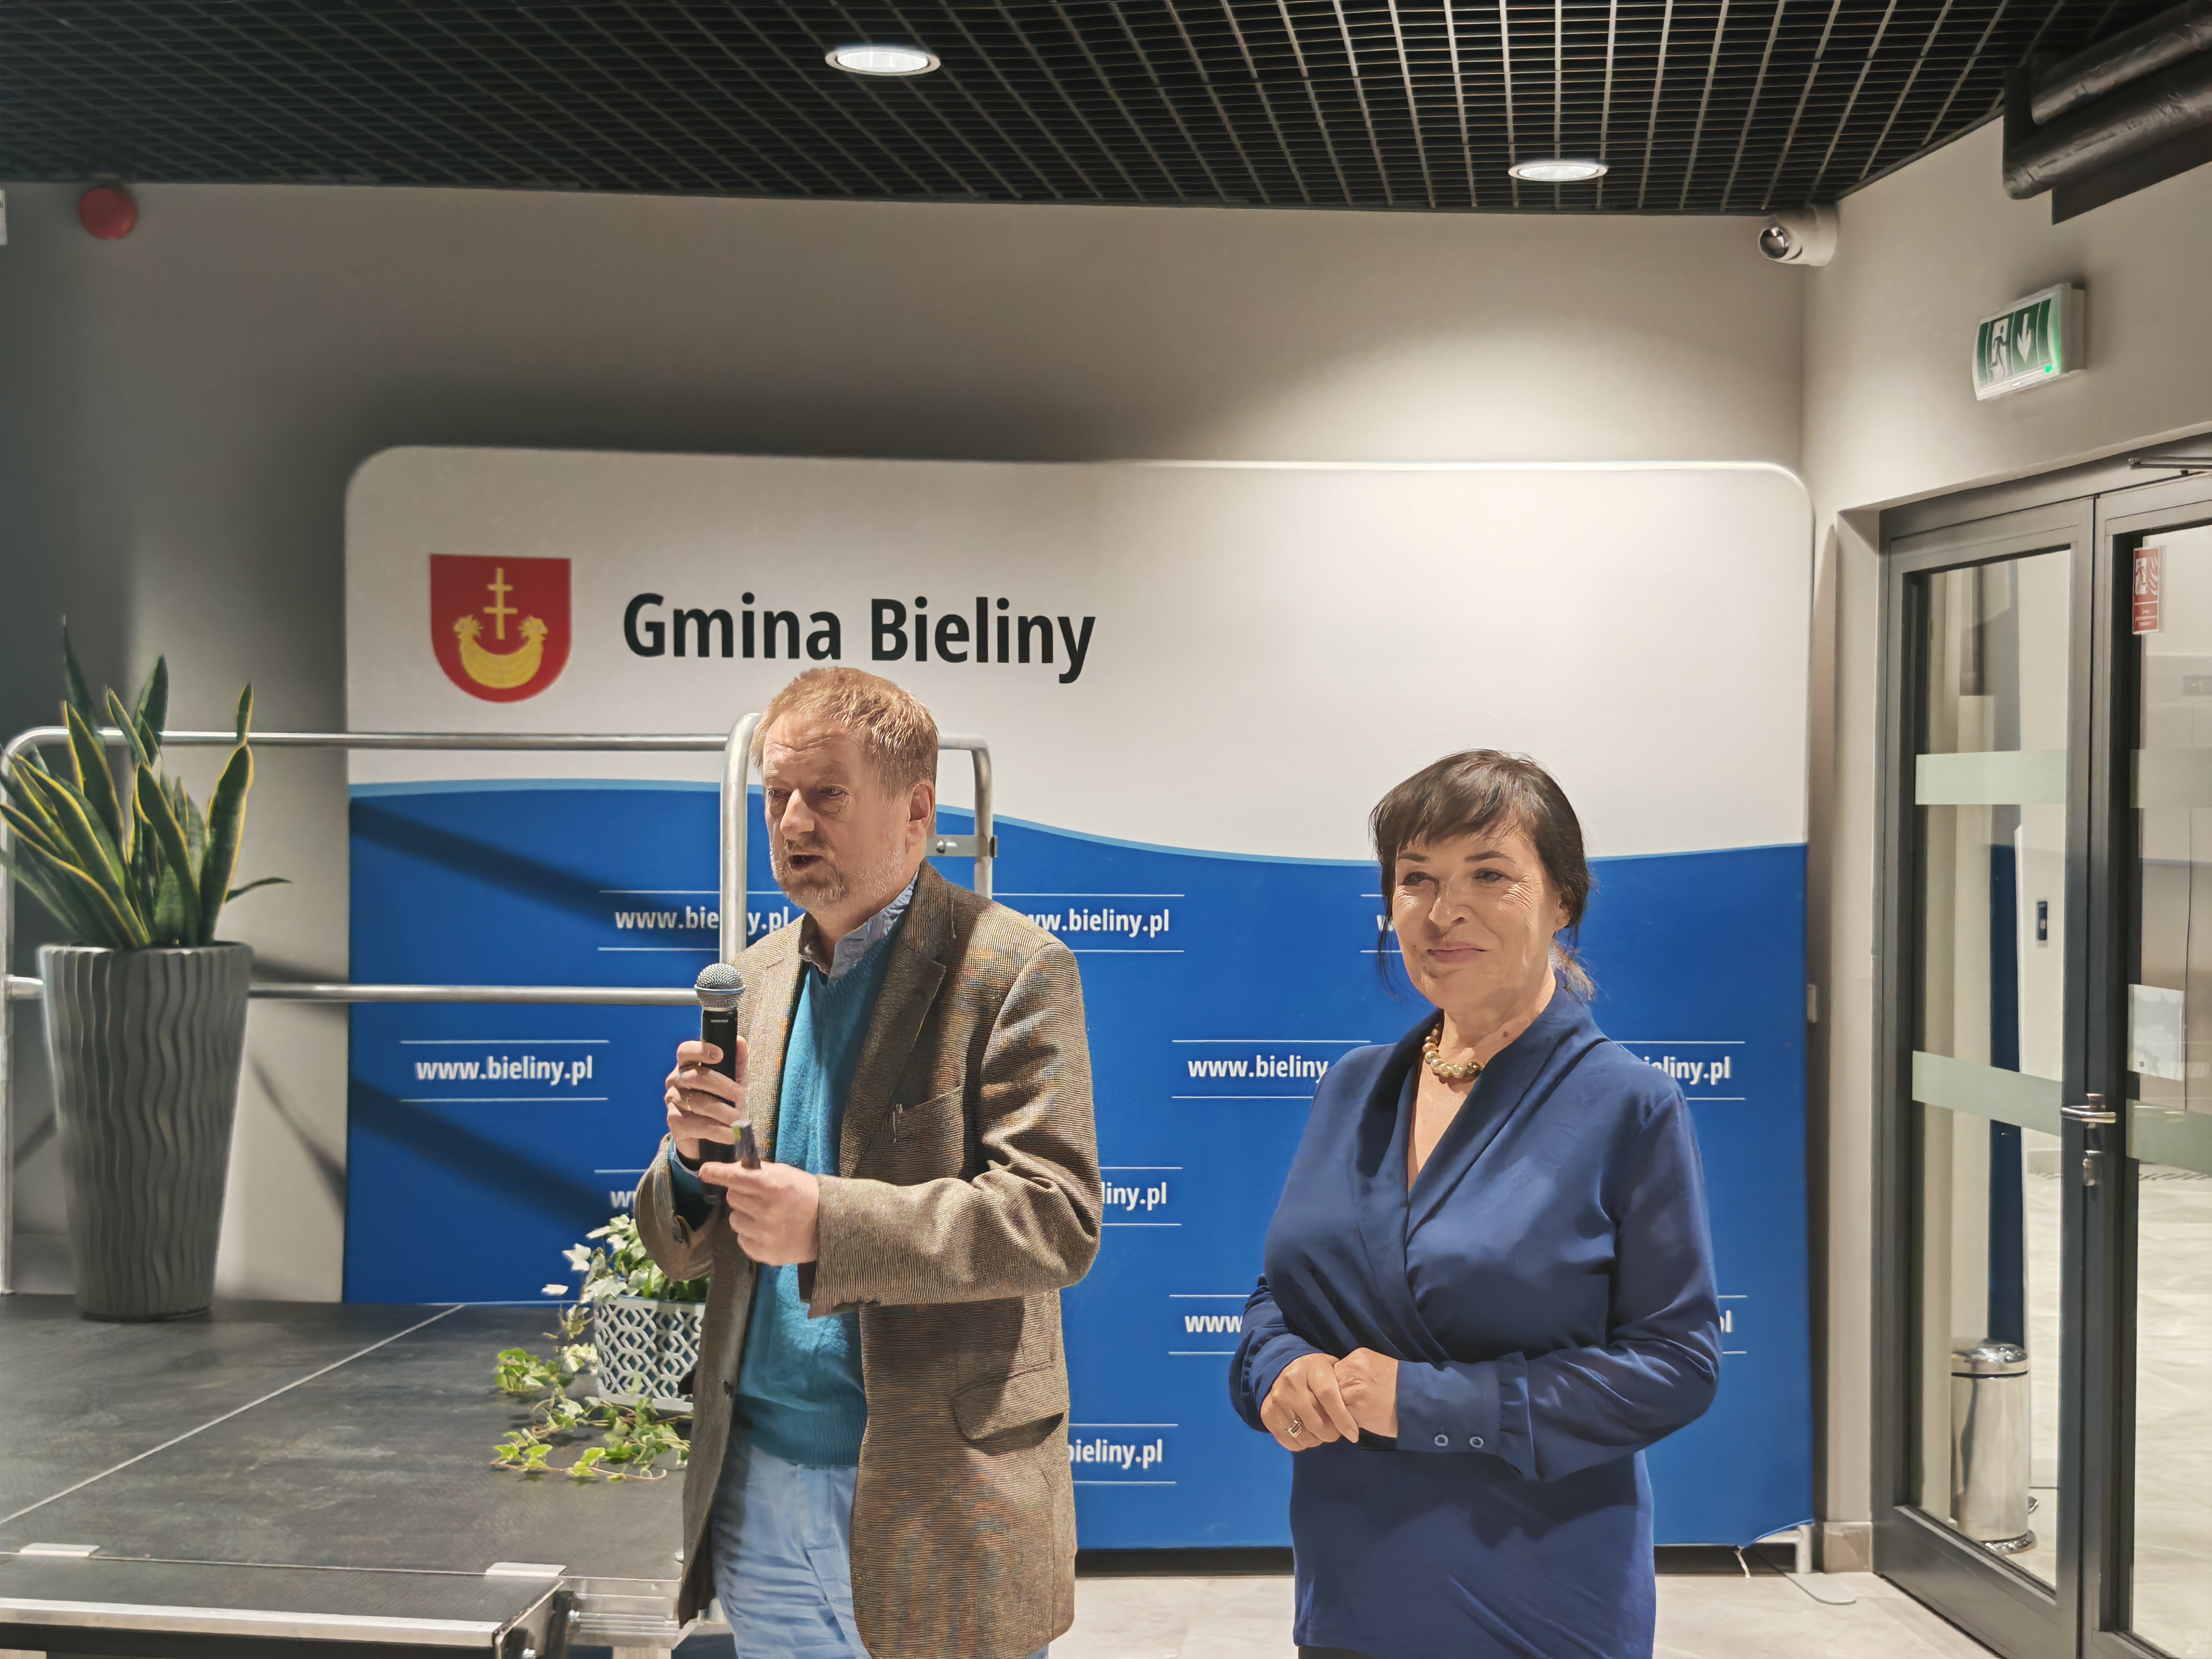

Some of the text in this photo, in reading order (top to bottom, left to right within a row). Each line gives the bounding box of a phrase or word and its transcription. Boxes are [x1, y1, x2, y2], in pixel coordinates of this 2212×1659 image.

[623, 591, 1096, 684] Gmina Bieliny
[614, 906, 789, 936] www.biey.pl
[414, 1055, 593, 1086] www.bieliny.pl
